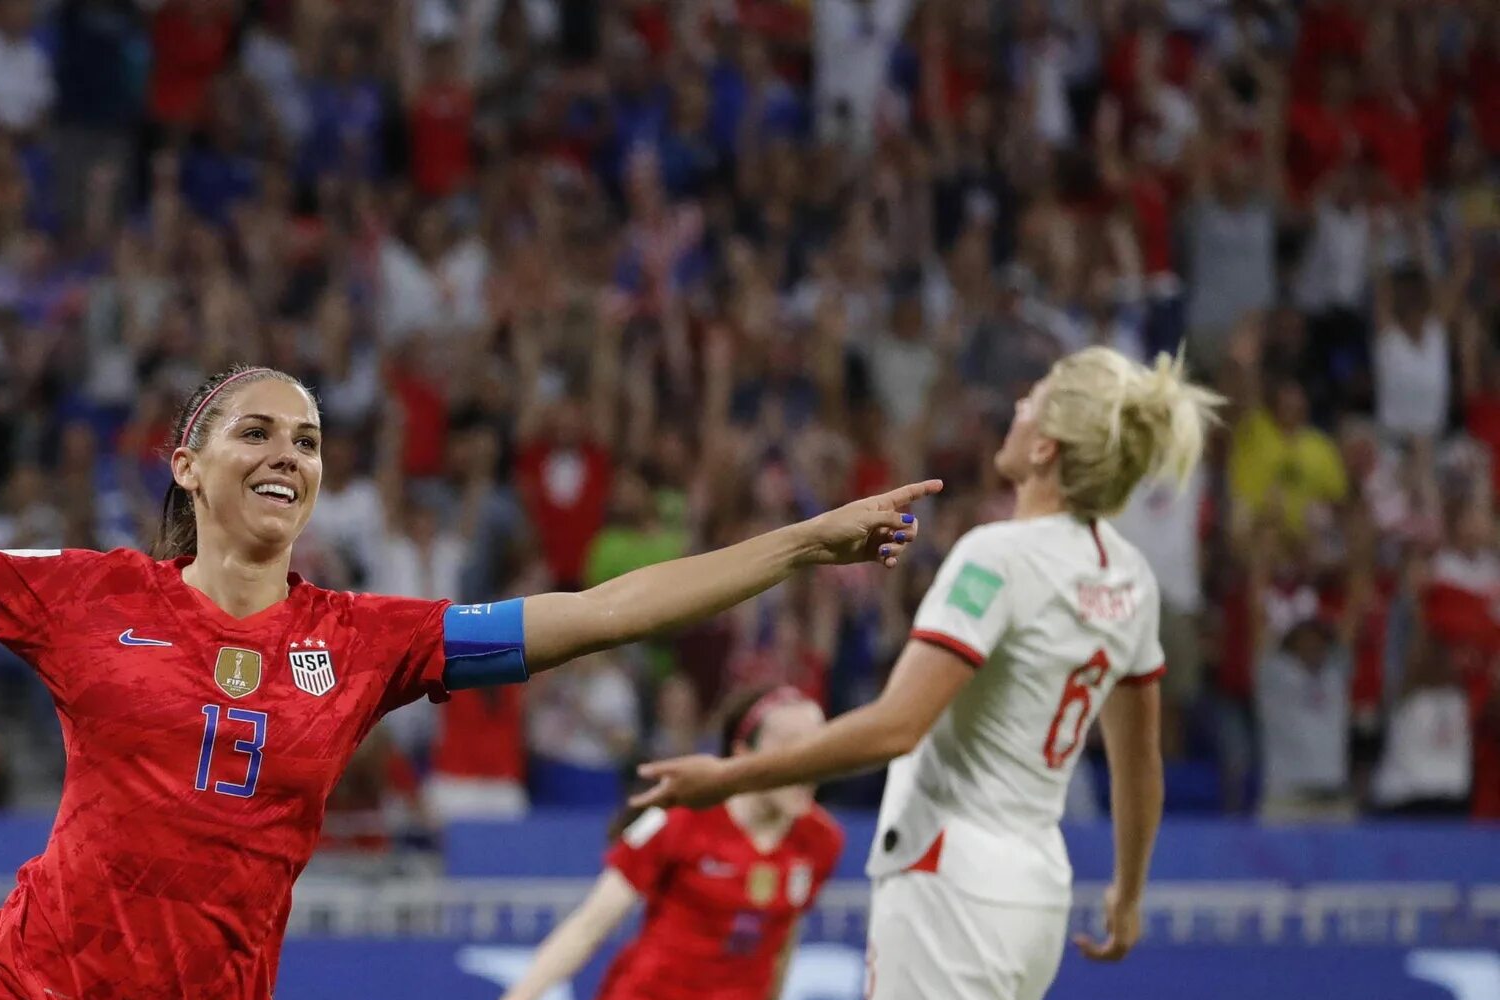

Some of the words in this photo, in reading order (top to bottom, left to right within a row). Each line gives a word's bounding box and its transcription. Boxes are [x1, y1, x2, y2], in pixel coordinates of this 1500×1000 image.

[226, 677, 246, 687] FIFA
[292, 654, 328, 672] USA
[1043, 648, 1110, 772] 6
[194, 703, 268, 799] 13
